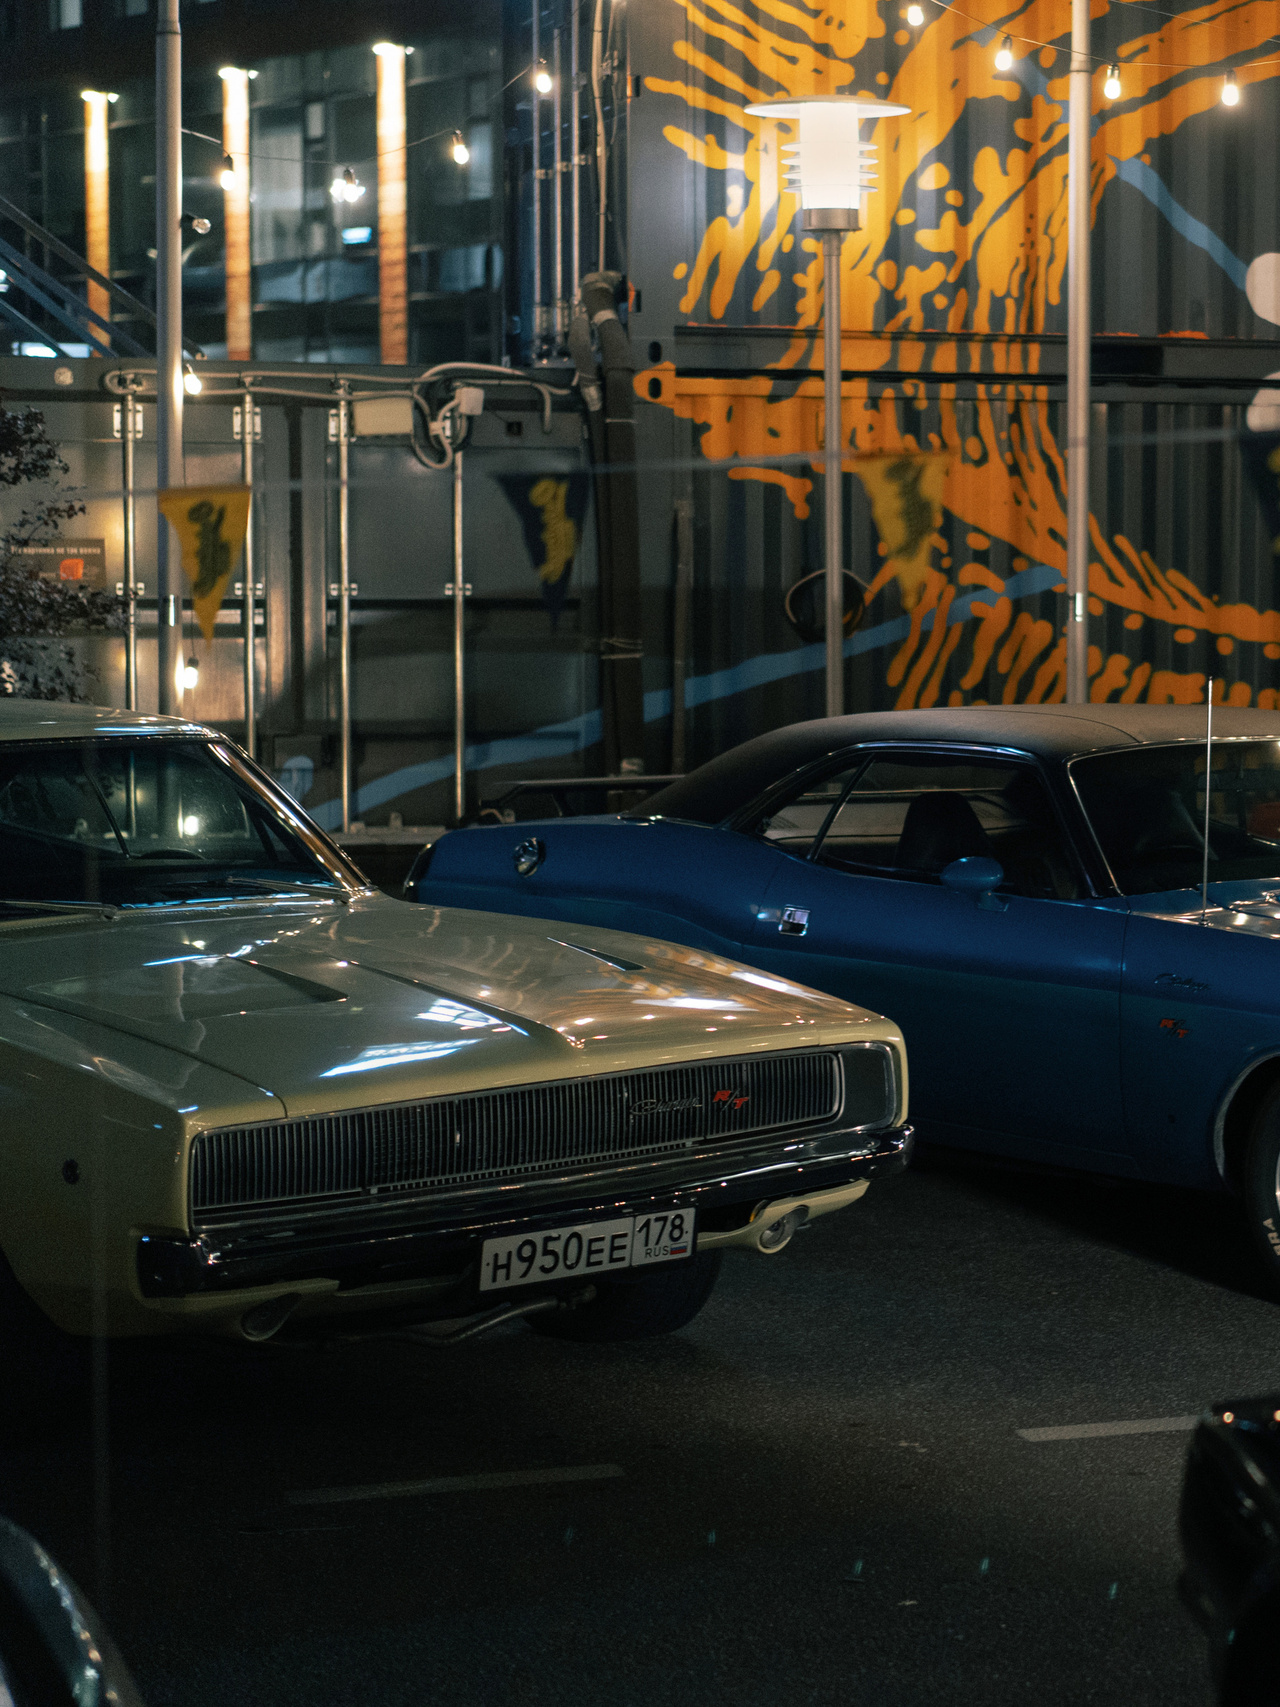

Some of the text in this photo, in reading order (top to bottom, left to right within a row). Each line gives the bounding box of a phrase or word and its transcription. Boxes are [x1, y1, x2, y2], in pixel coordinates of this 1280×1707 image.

[712, 1088, 750, 1112] R/T
[636, 1213, 685, 1248] 178
[644, 1245, 670, 1259] RUS
